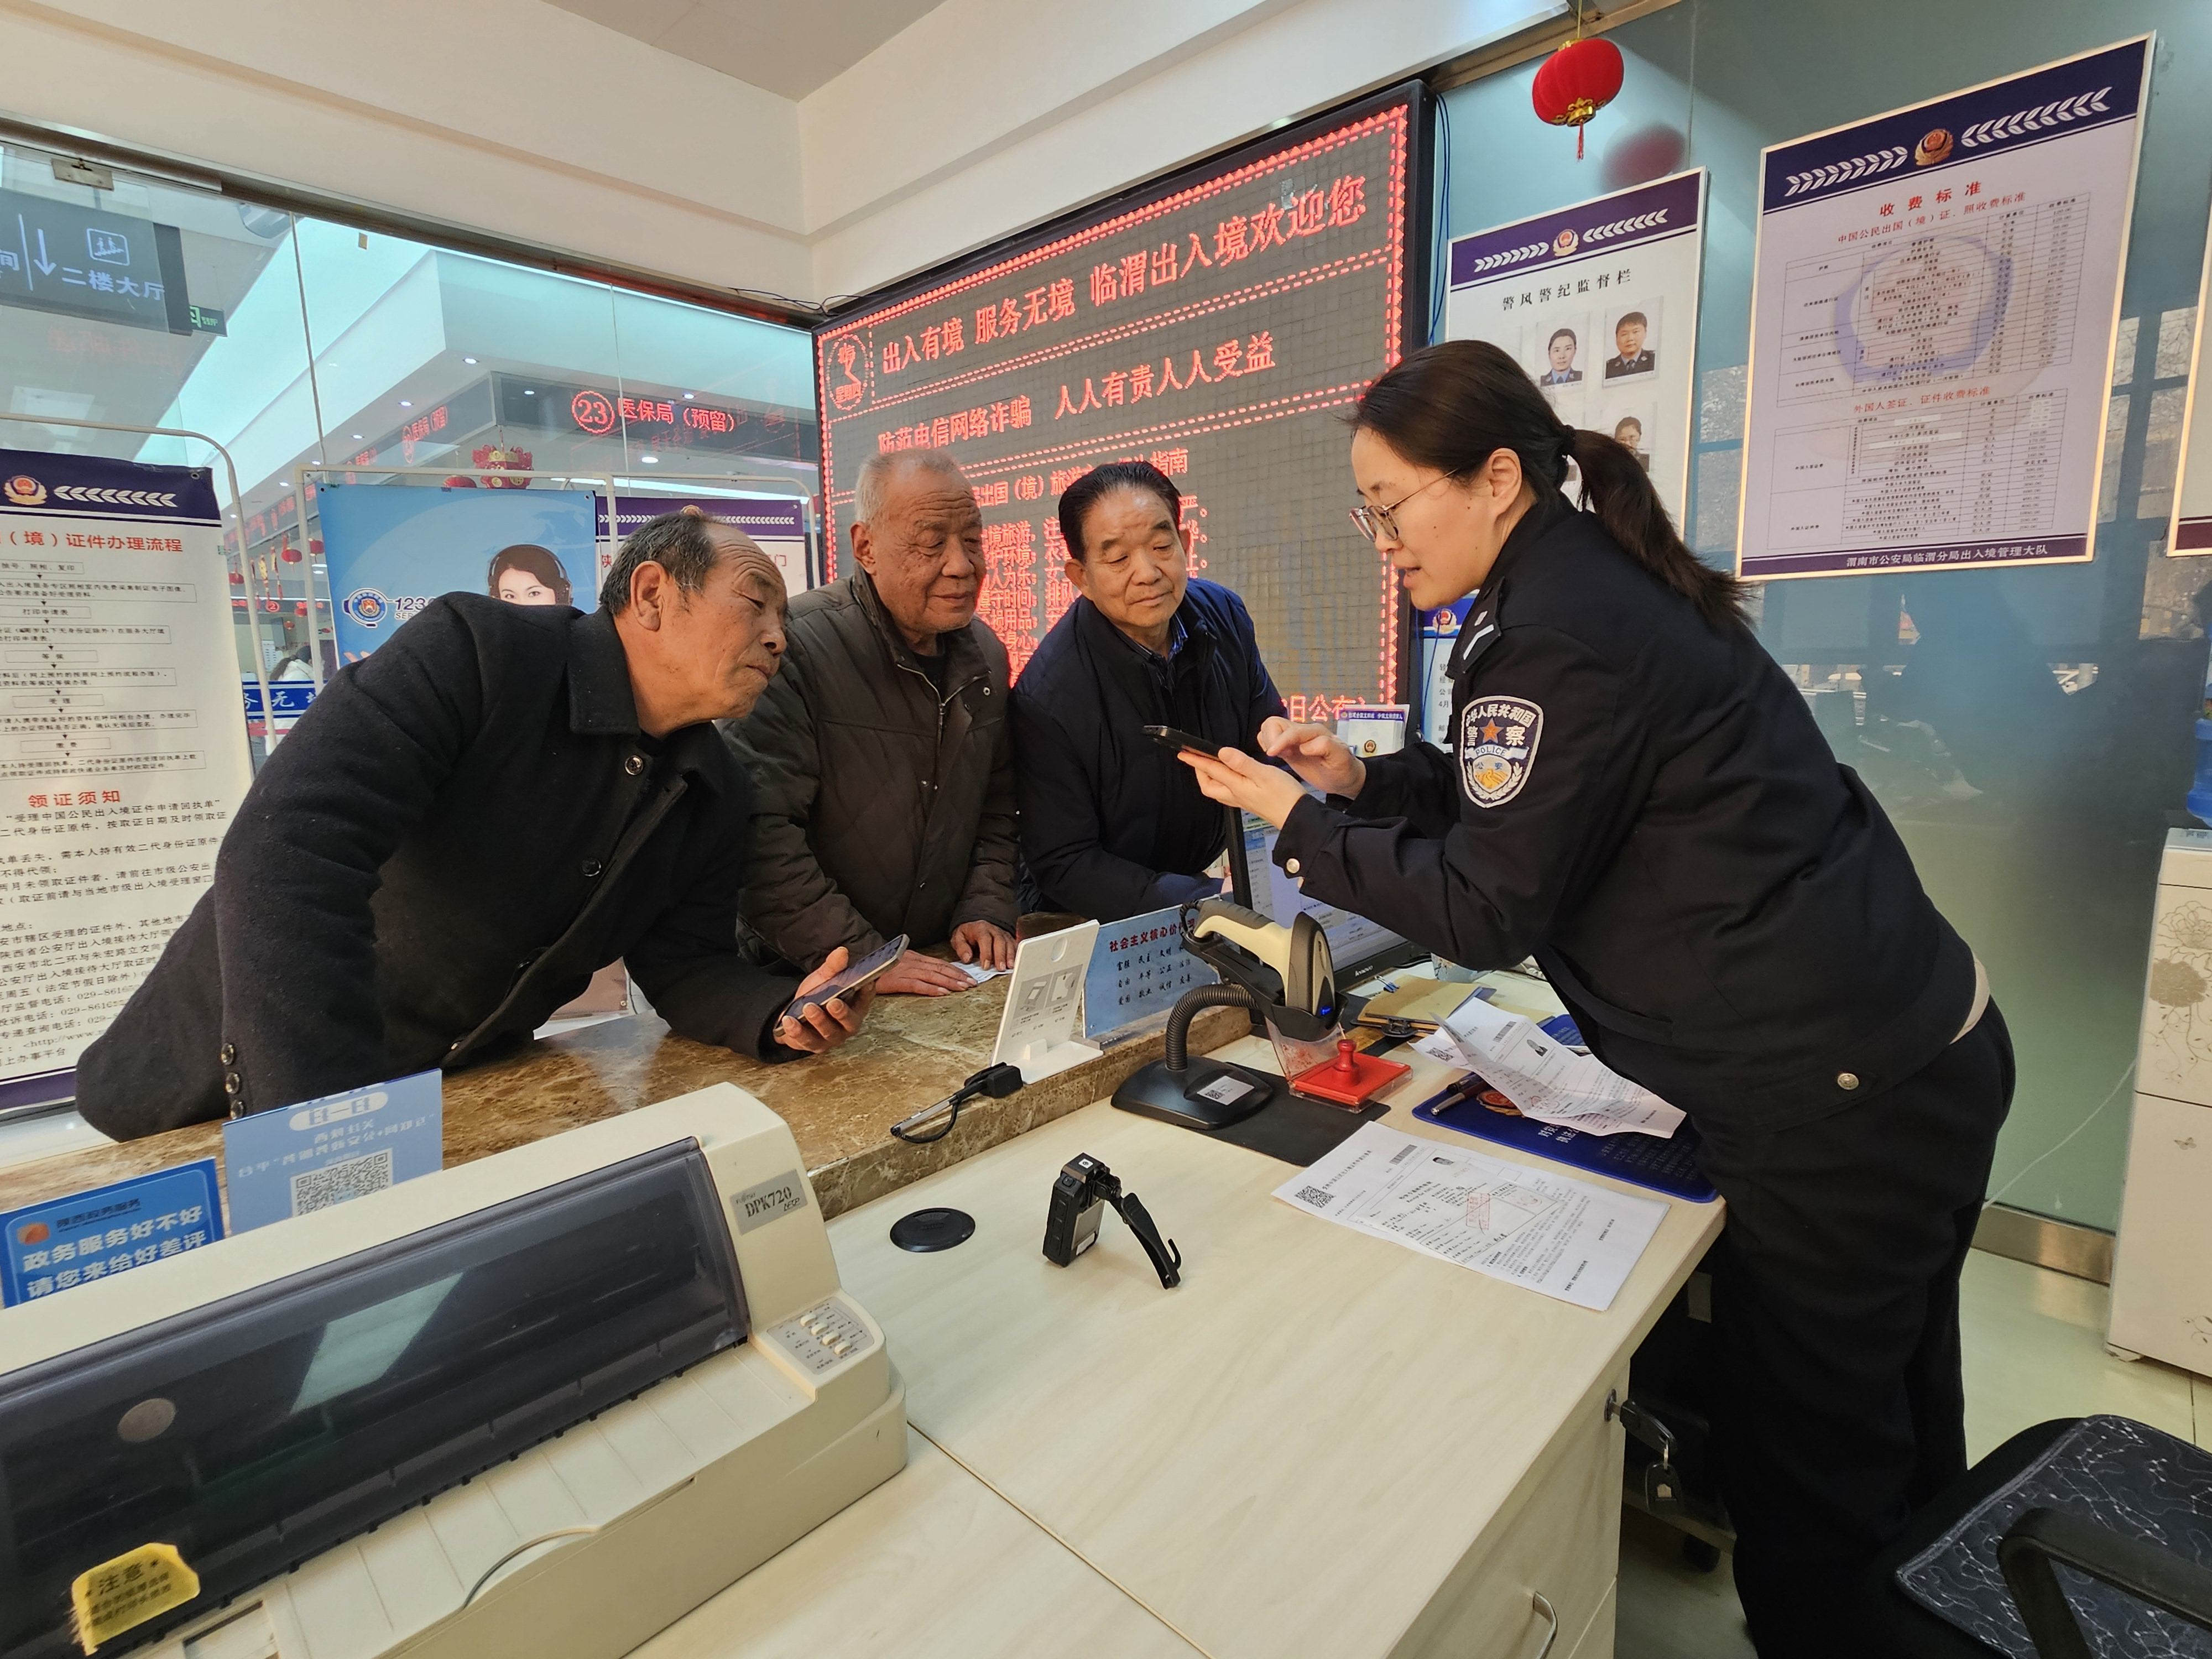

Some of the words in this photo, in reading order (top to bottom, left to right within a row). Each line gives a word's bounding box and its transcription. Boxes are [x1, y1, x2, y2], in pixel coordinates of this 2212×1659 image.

[1880, 181, 1982, 217] 收费标准
[62, 267, 165, 300] 二楼大厅
[883, 319, 964, 375] 出入有境
[975, 278, 1075, 345] 服务无境
[1090, 175, 1367, 307] 临渭出入境欢迎您
[1503, 269, 1631, 311] 警风警纪监督栏
[618, 398, 734, 434] 医保局（预留）
[878, 394, 1031, 453] 防范电信网络诈骗
[0, 530, 183, 552] （境）证件办理流程
[1846, 544, 2049, 567] 渭南市公安局临渭分局出入境管理大队
[1475, 747, 1507, 757] POLICE
[28, 790, 121, 808] 领证须知
[0, 836, 224, 864] 单丢失，需本人持有效二代身份证原件
[0, 914, 191, 946] 安市辖区受理的证件外，其他地市
[0, 928, 178, 959] 陕西省公安厅出入境接待大厅领
[0, 956, 159, 987] 公安厅出入境接待大厅取证时
[2, 942, 168, 973] 西安市北二环与朱宏路立交向
[745, 1186, 792, 1218] DPK720
[23, 1205, 202, 1272] 政务服务好不好
[27, 1230, 207, 1298] 请您来给好差评
